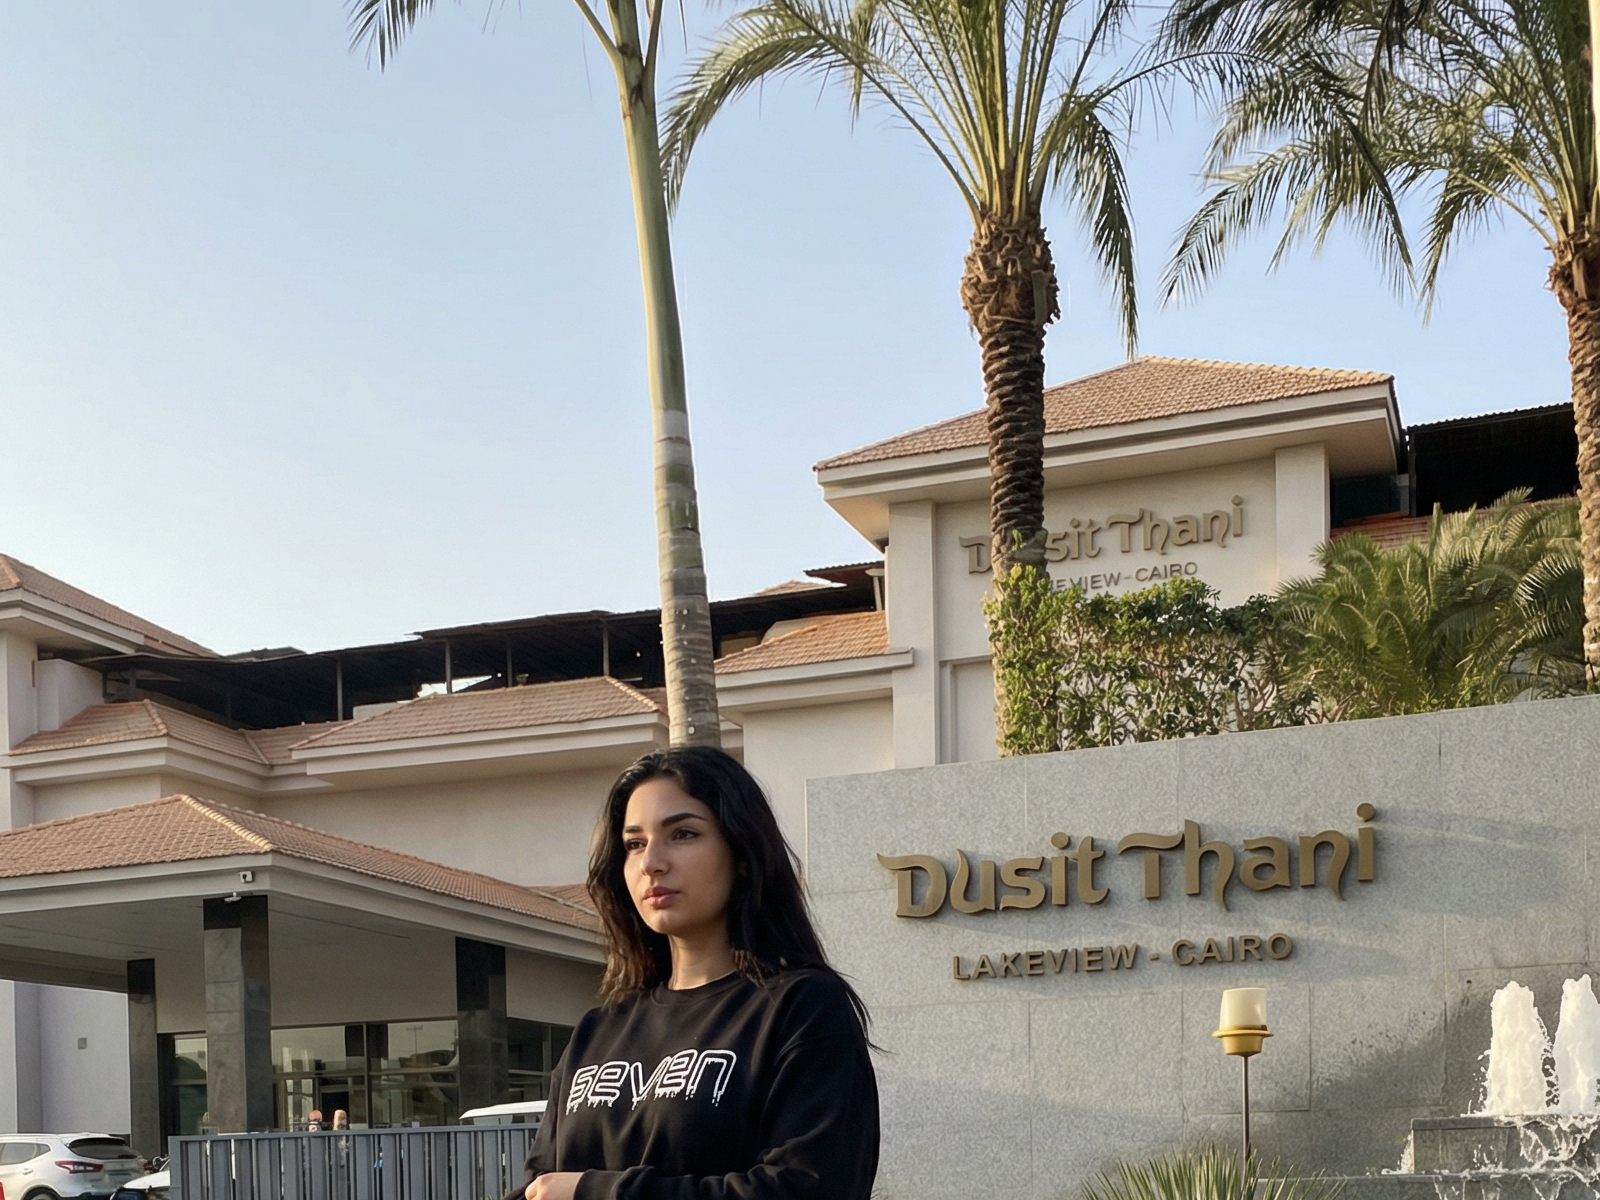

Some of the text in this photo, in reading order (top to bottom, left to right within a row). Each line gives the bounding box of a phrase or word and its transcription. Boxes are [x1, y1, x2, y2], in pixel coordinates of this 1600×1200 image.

[959, 495, 1244, 575] Dsit Thani
[876, 802, 1377, 918] Dusit Thani
[952, 942, 1139, 981] LAKEVIEW
[1171, 932, 1293, 966] CAIRO
